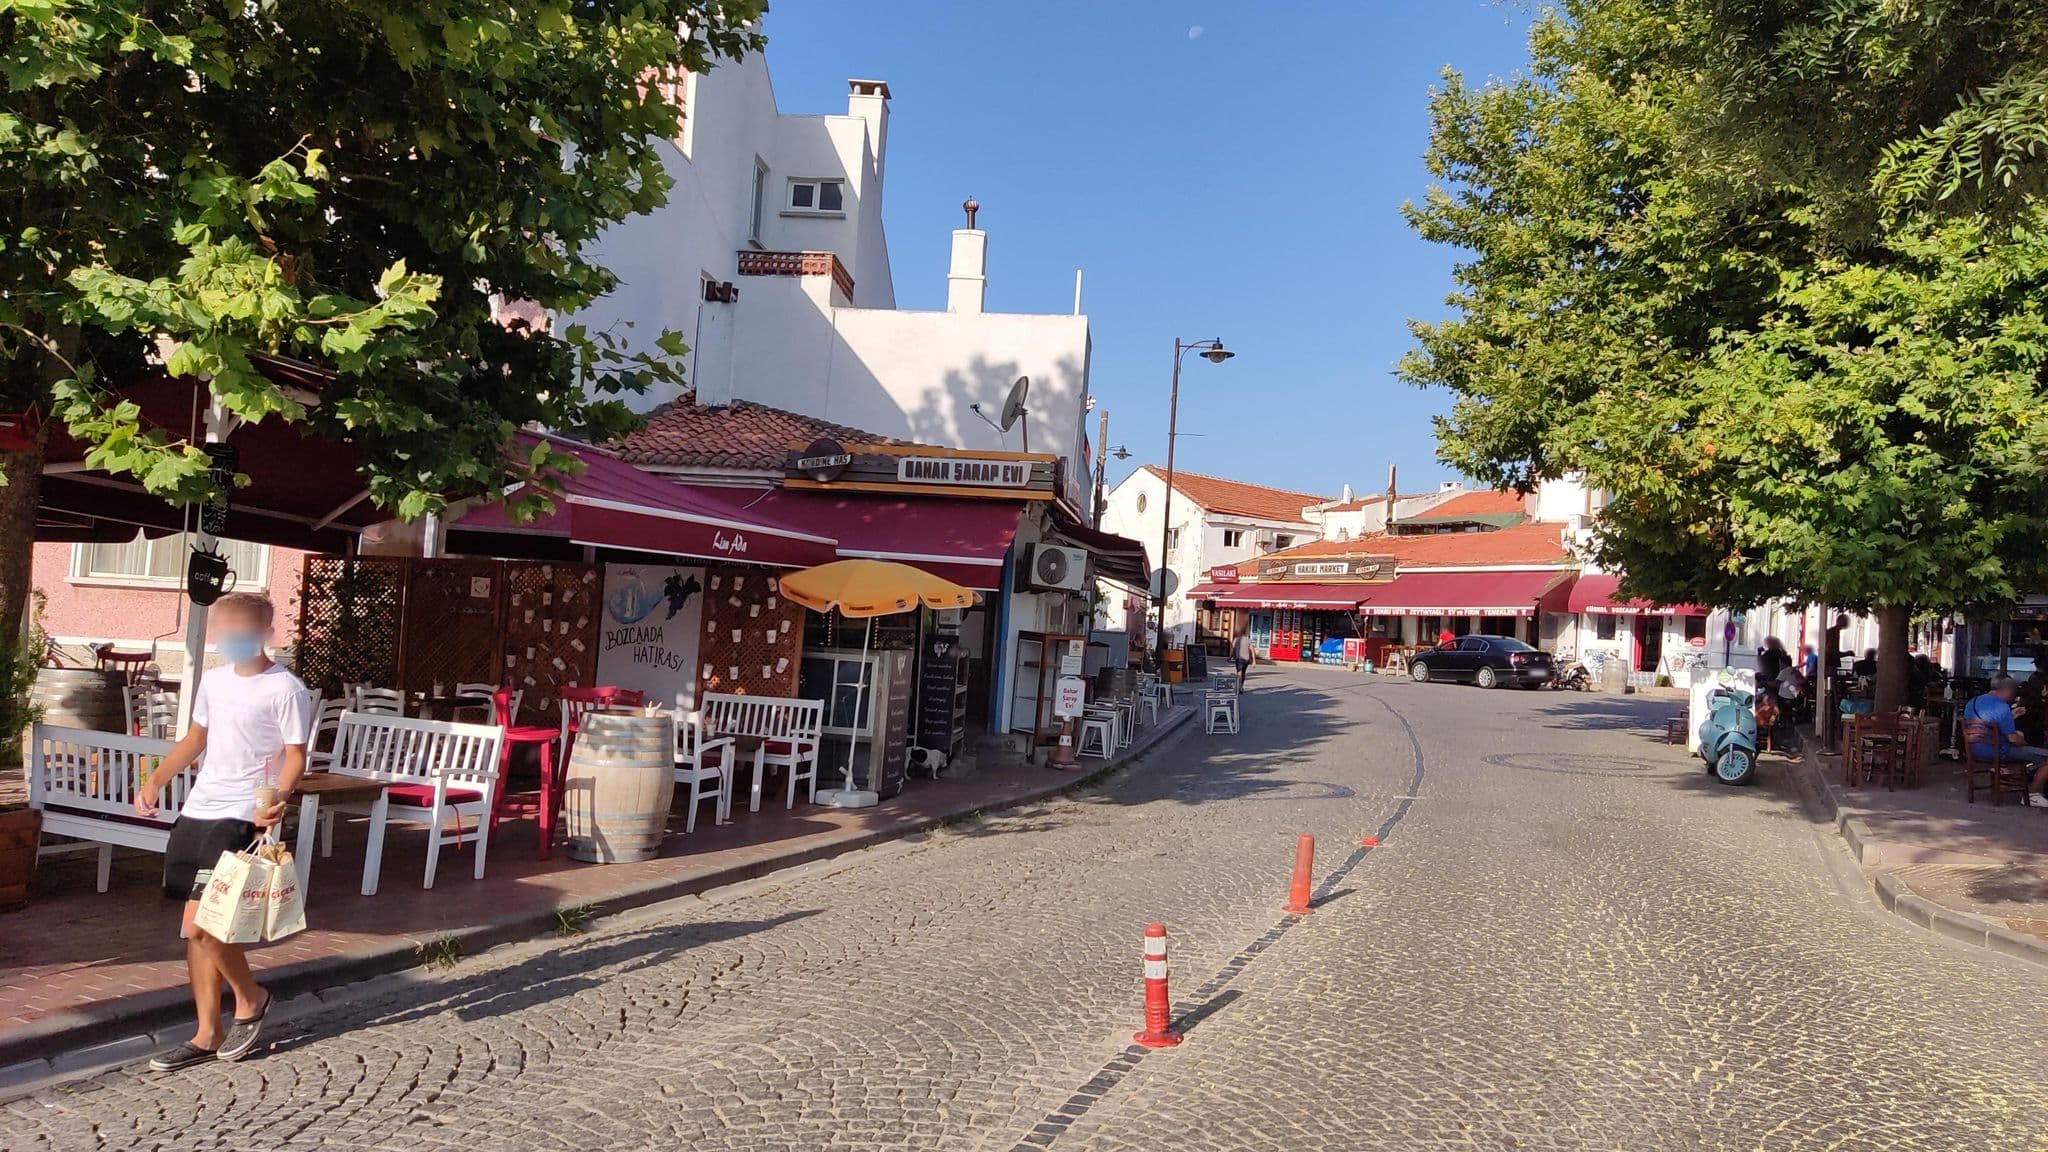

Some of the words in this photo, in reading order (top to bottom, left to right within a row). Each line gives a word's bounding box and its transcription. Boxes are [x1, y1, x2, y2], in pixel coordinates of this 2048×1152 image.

[905, 460, 949, 480] BAHAR
[1319, 563, 1345, 574] MARKET
[195, 571, 219, 586] coffee
[605, 627, 664, 650] BOZCAADA
